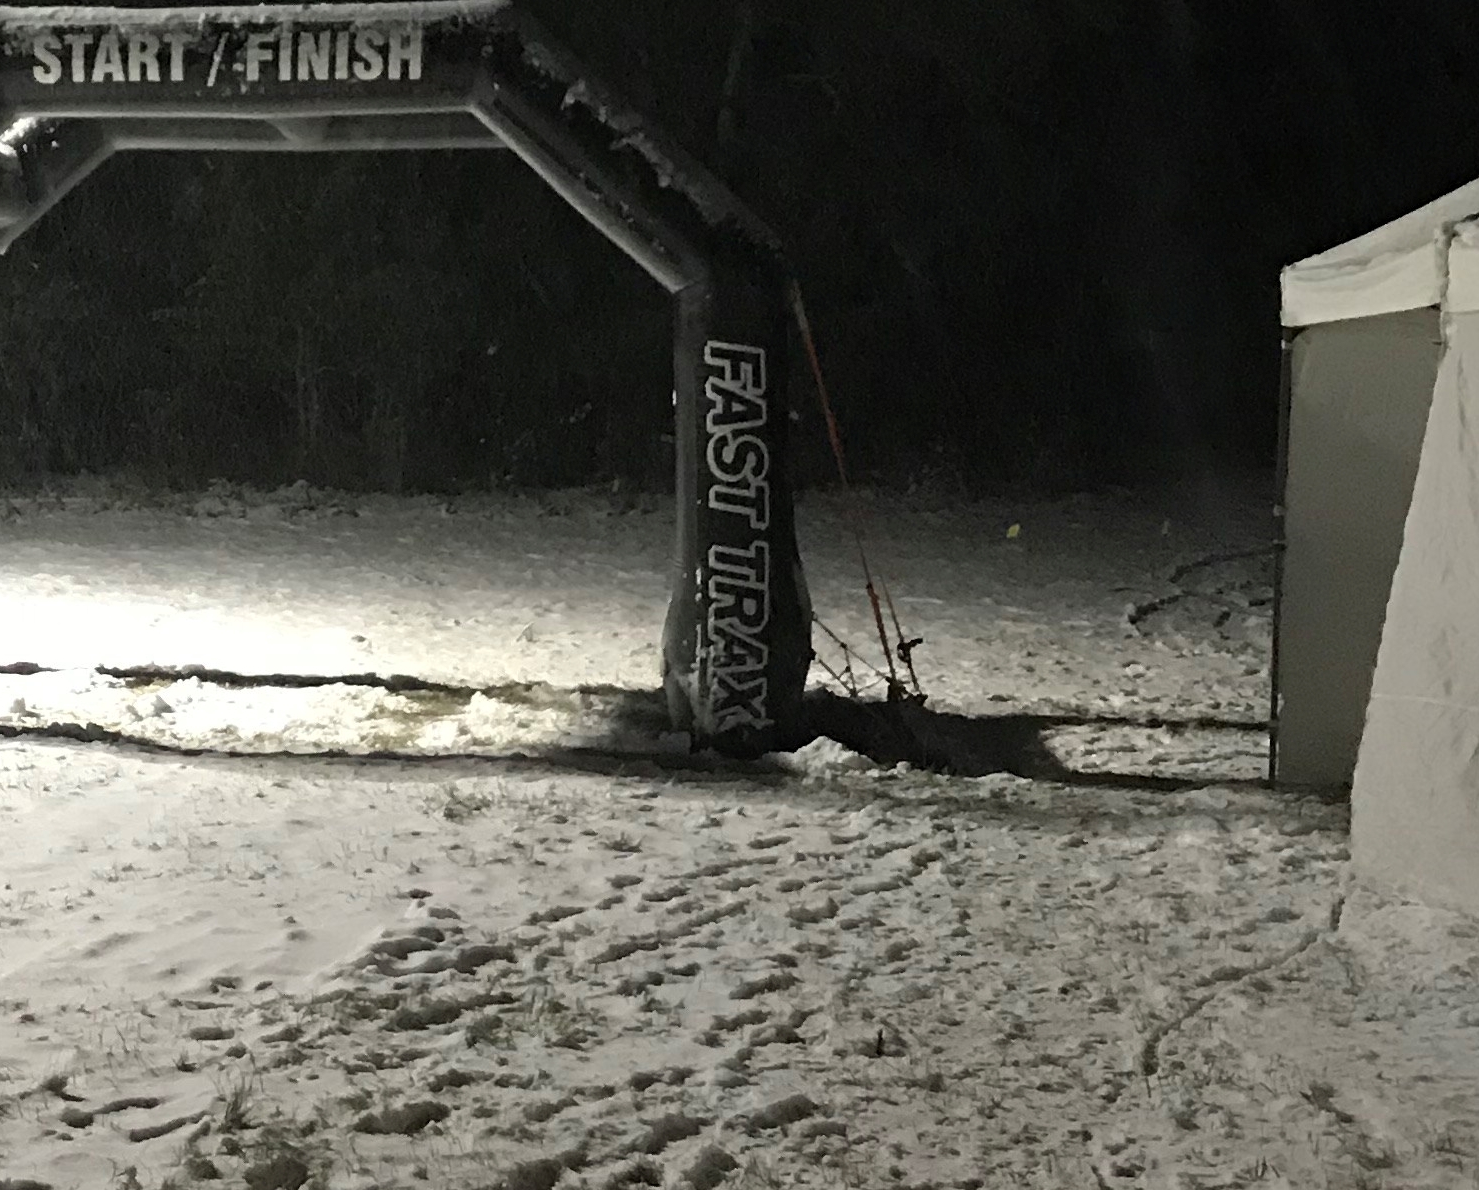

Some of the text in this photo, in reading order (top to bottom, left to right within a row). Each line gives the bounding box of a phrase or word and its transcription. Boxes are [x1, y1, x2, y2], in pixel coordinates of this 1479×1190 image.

[32, 30, 192, 85] START
[246, 29, 422, 82] FINISH
[704, 340, 773, 729] FAST TRAX
